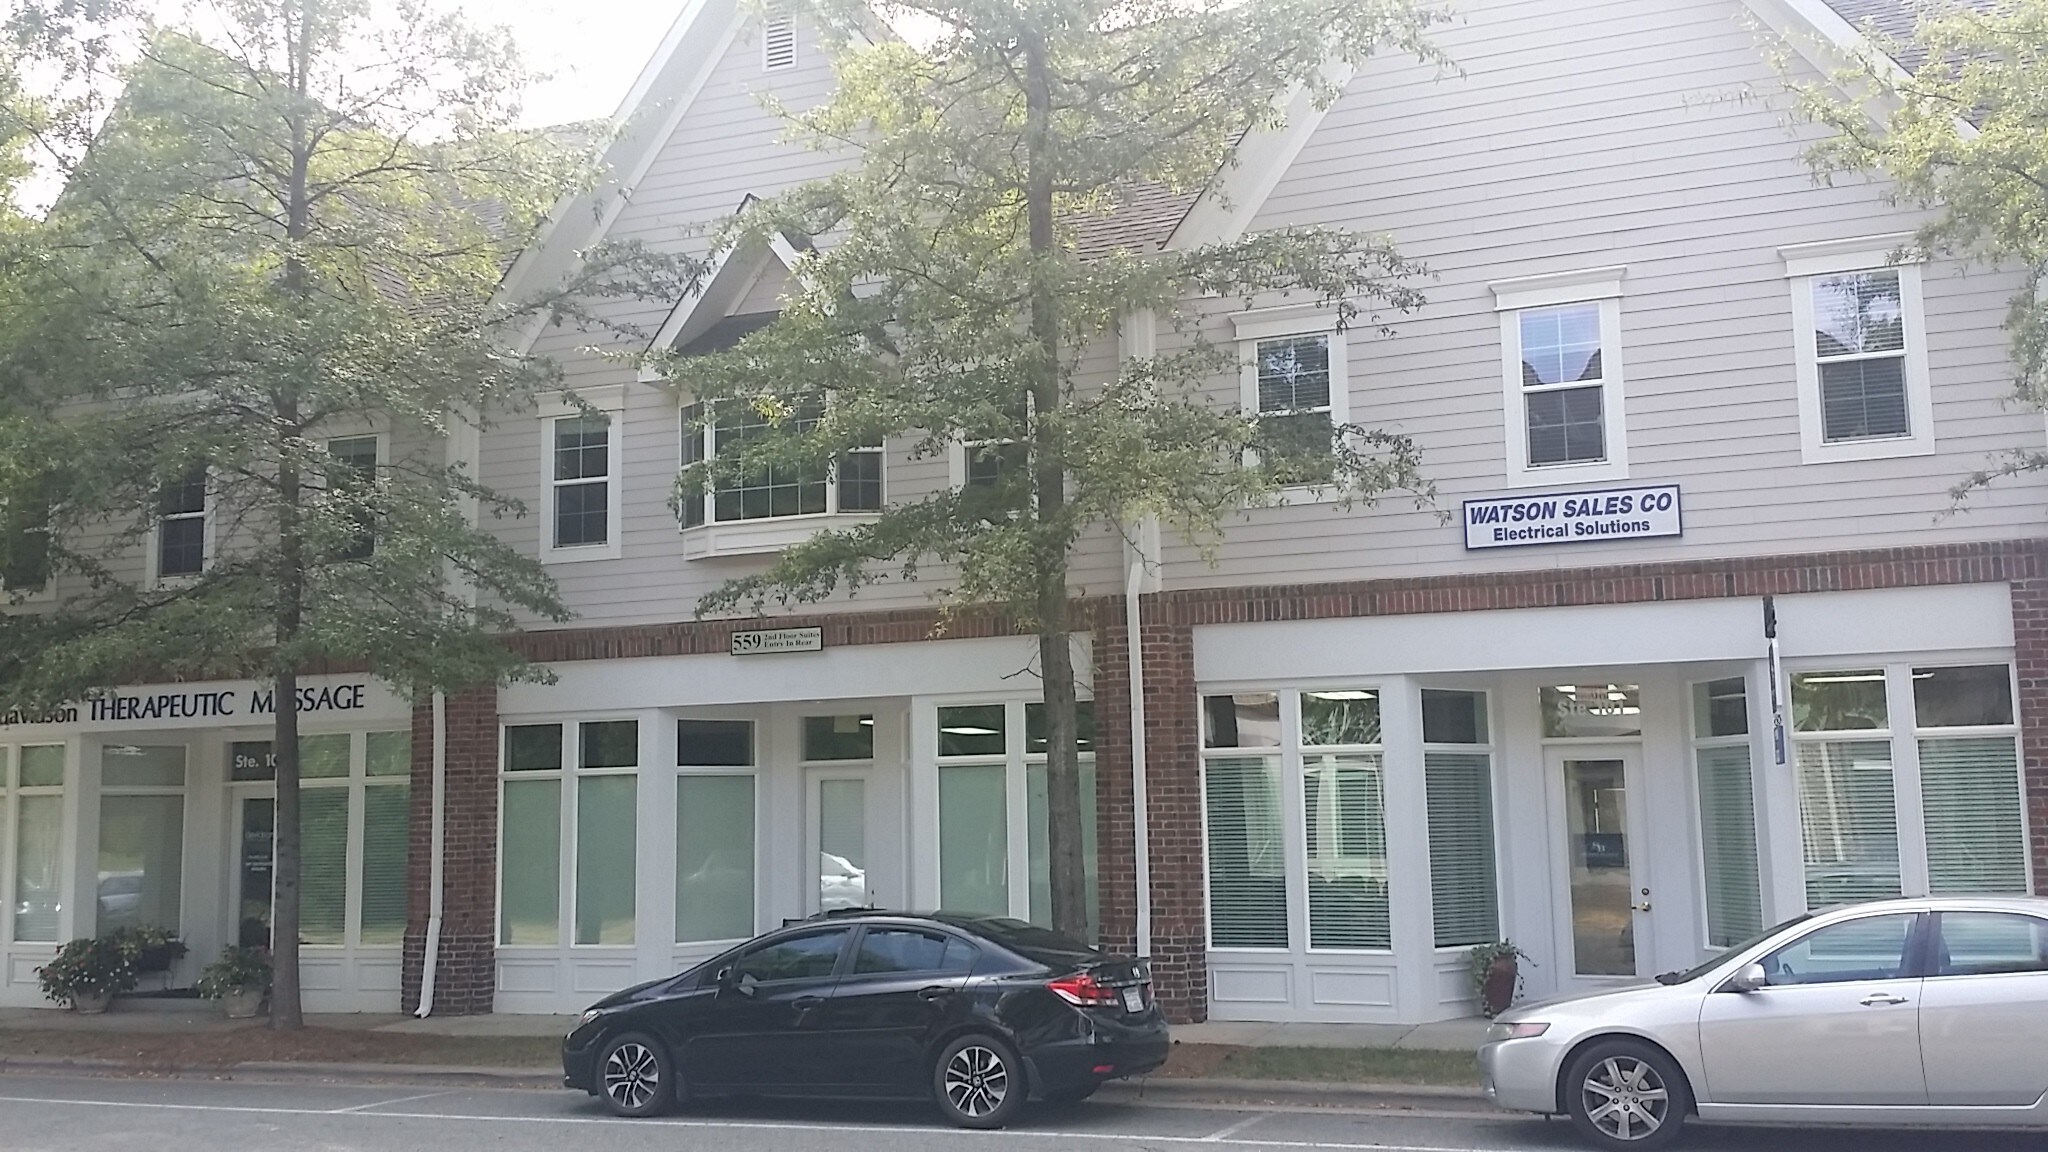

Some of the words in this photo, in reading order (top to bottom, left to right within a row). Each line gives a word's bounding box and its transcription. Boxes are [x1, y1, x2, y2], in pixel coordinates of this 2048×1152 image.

[1470, 501, 1557, 525] WATSON
[1563, 495, 1633, 517] SALES
[1640, 492, 1672, 512] CO
[1493, 522, 1569, 541] Electrical
[1574, 520, 1650, 537] Solutions
[733, 634, 761, 651] 559
[764, 633, 777, 641] 2nd
[779, 632, 797, 640] Floor
[799, 631, 820, 639] Suites
[764, 640, 783, 648] Entry
[795, 639, 812, 647] Rear
[87, 691, 235, 721] THERAPEUTIC
[250, 684, 365, 714] MSSAGE
[235, 754, 260, 769] Ste.
